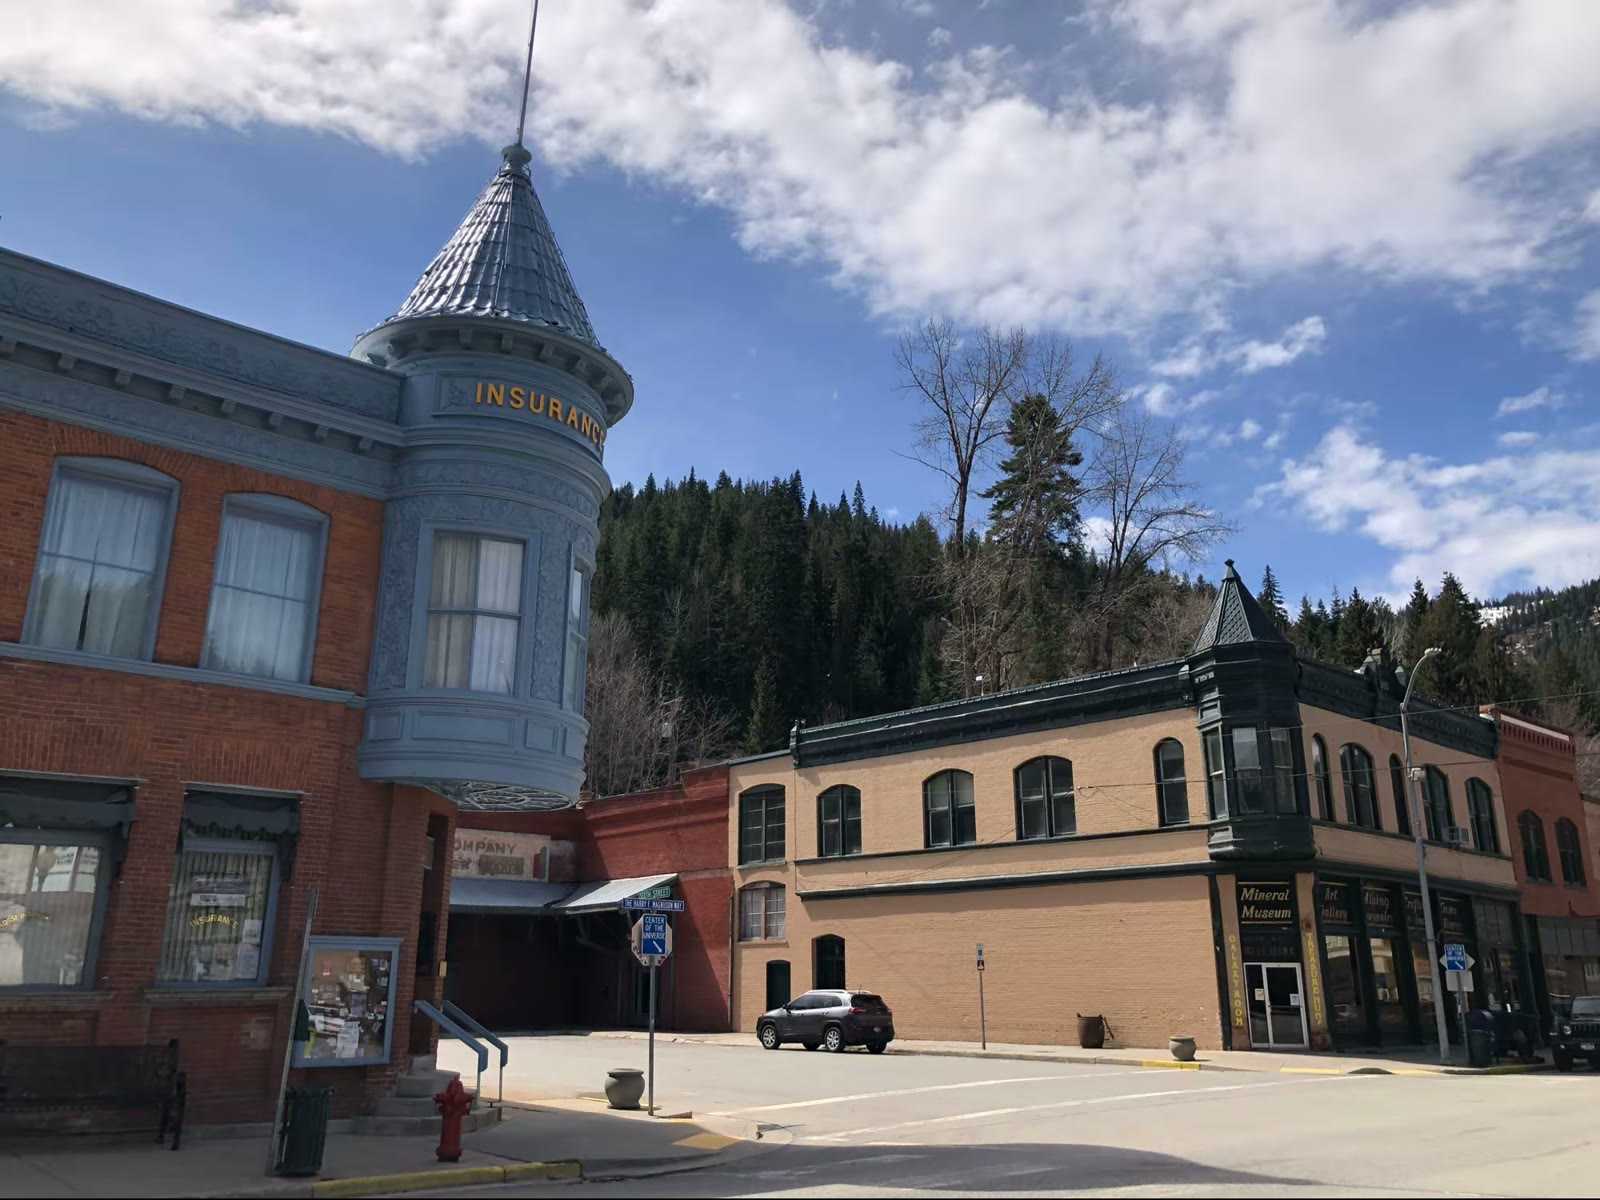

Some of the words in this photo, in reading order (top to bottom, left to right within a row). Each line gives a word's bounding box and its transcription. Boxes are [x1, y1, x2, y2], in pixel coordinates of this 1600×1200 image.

[475, 381, 605, 452] INSURANCE
[453, 839, 516, 854] OMPANY
[652, 887, 669, 897] STREET
[1241, 887, 1290, 901] Mineral
[1325, 887, 1338, 901] Art
[624, 899, 633, 908] THE
[633, 900, 647, 908] HARRY
[652, 901, 674, 910] MAGNUSON
[674, 902, 683, 910] WAY
[1241, 905, 1291, 918] Museum
[0, 914, 18, 928] OSSI
[189, 913, 239, 929] INSURANCE
[645, 916, 665, 924] CENTER
[654, 924, 664, 932] THE
[1234, 990, 1243, 1026] ROOM
